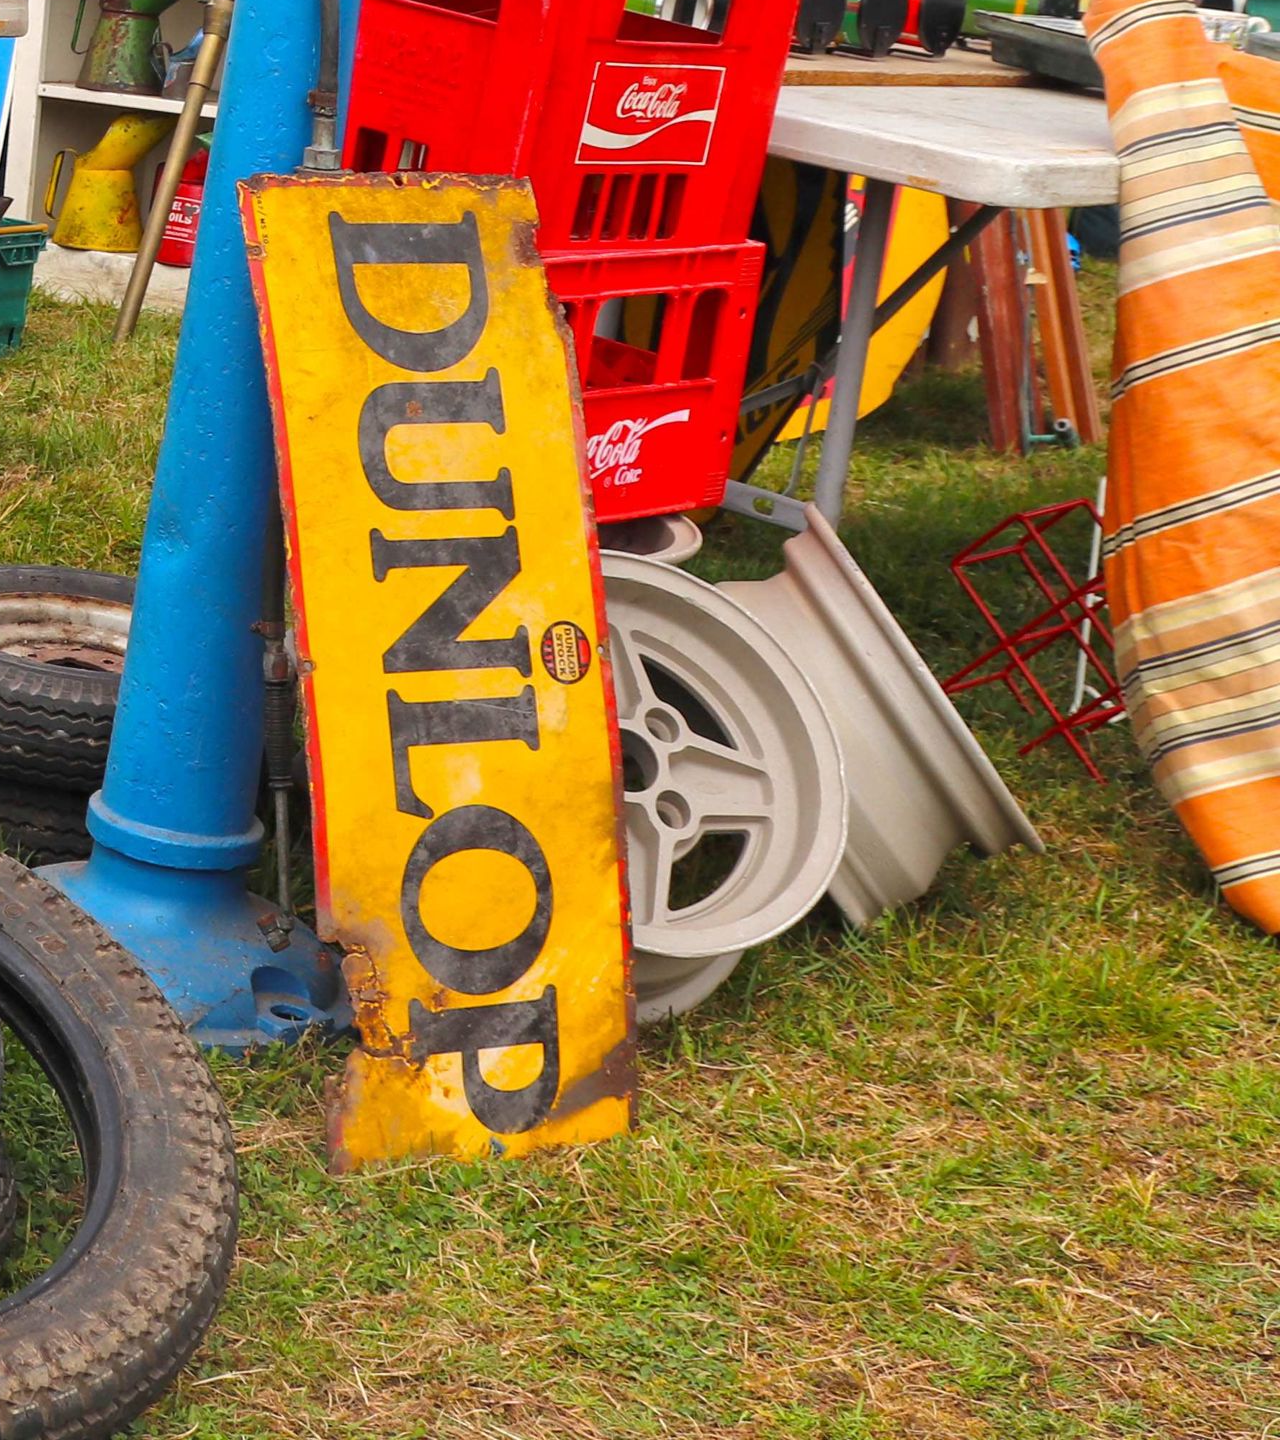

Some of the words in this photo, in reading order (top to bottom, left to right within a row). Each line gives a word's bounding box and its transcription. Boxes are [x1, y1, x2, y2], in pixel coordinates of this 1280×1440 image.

[616, 82, 687, 118] Coca-Cola
[168, 212, 192, 225] OILS
[327, 209, 562, 1135] DUNLOP
[556, 633, 567, 676] STOCK
[564, 627, 577, 678] DUNLOP
